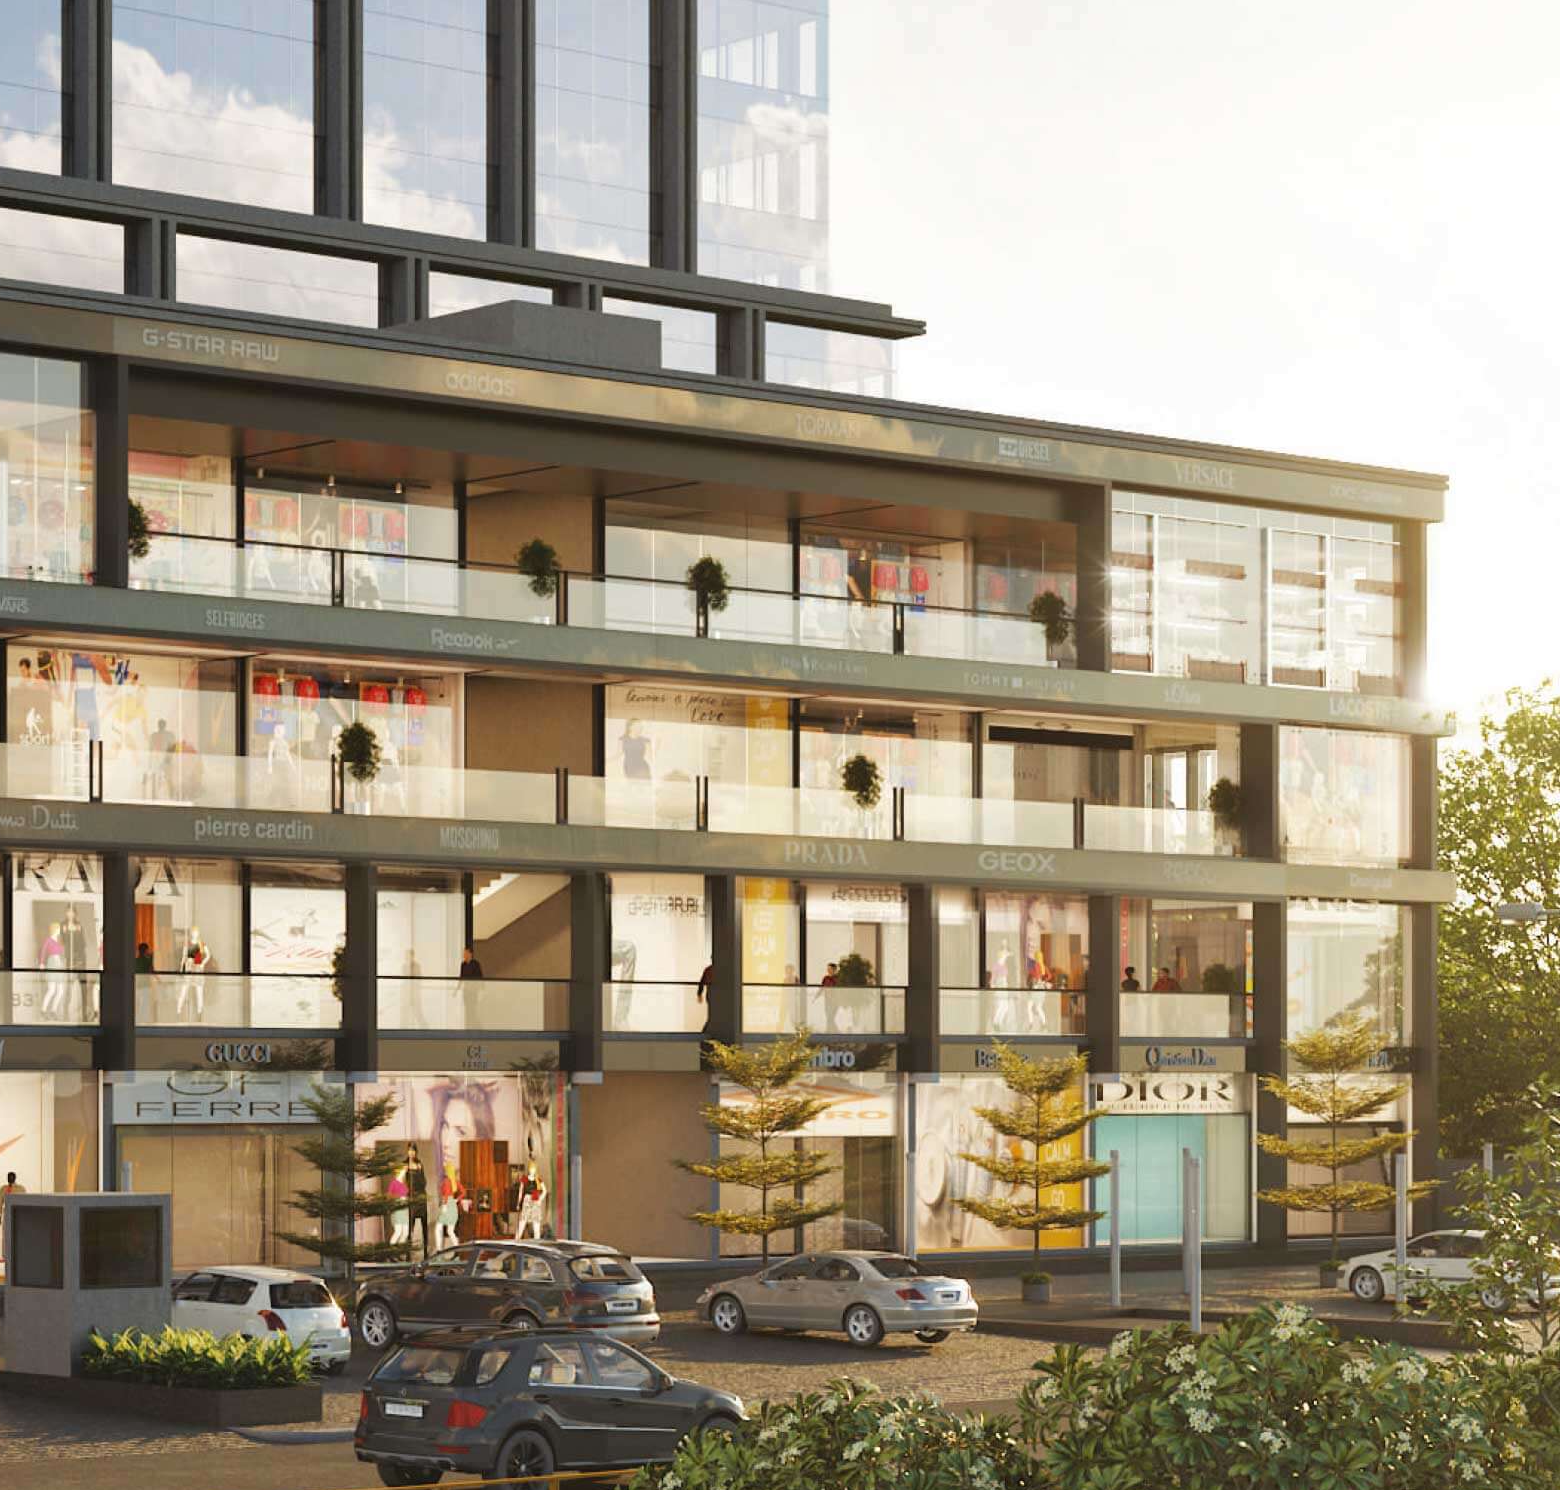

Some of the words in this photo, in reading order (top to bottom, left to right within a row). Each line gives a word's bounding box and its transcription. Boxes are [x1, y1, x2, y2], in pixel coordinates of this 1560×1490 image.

[142, 327, 225, 355] G-STAR
[231, 339, 280, 361] RAW
[445, 370, 515, 397] adidas
[1175, 462, 1236, 489] VERSACE
[205, 610, 267, 630] SELFRIDGES
[431, 628, 494, 650] Reebok
[32, 805, 79, 831] Dutti
[194, 816, 250, 841] pierre
[255, 820, 314, 841] cardin
[439, 825, 500, 850] MOSCHINO
[783, 840, 870, 867] PRADA
[977, 850, 1057, 874] GEOX
[205, 1043, 272, 1063] GUCCI
[1096, 1079, 1234, 1102] DIOR
